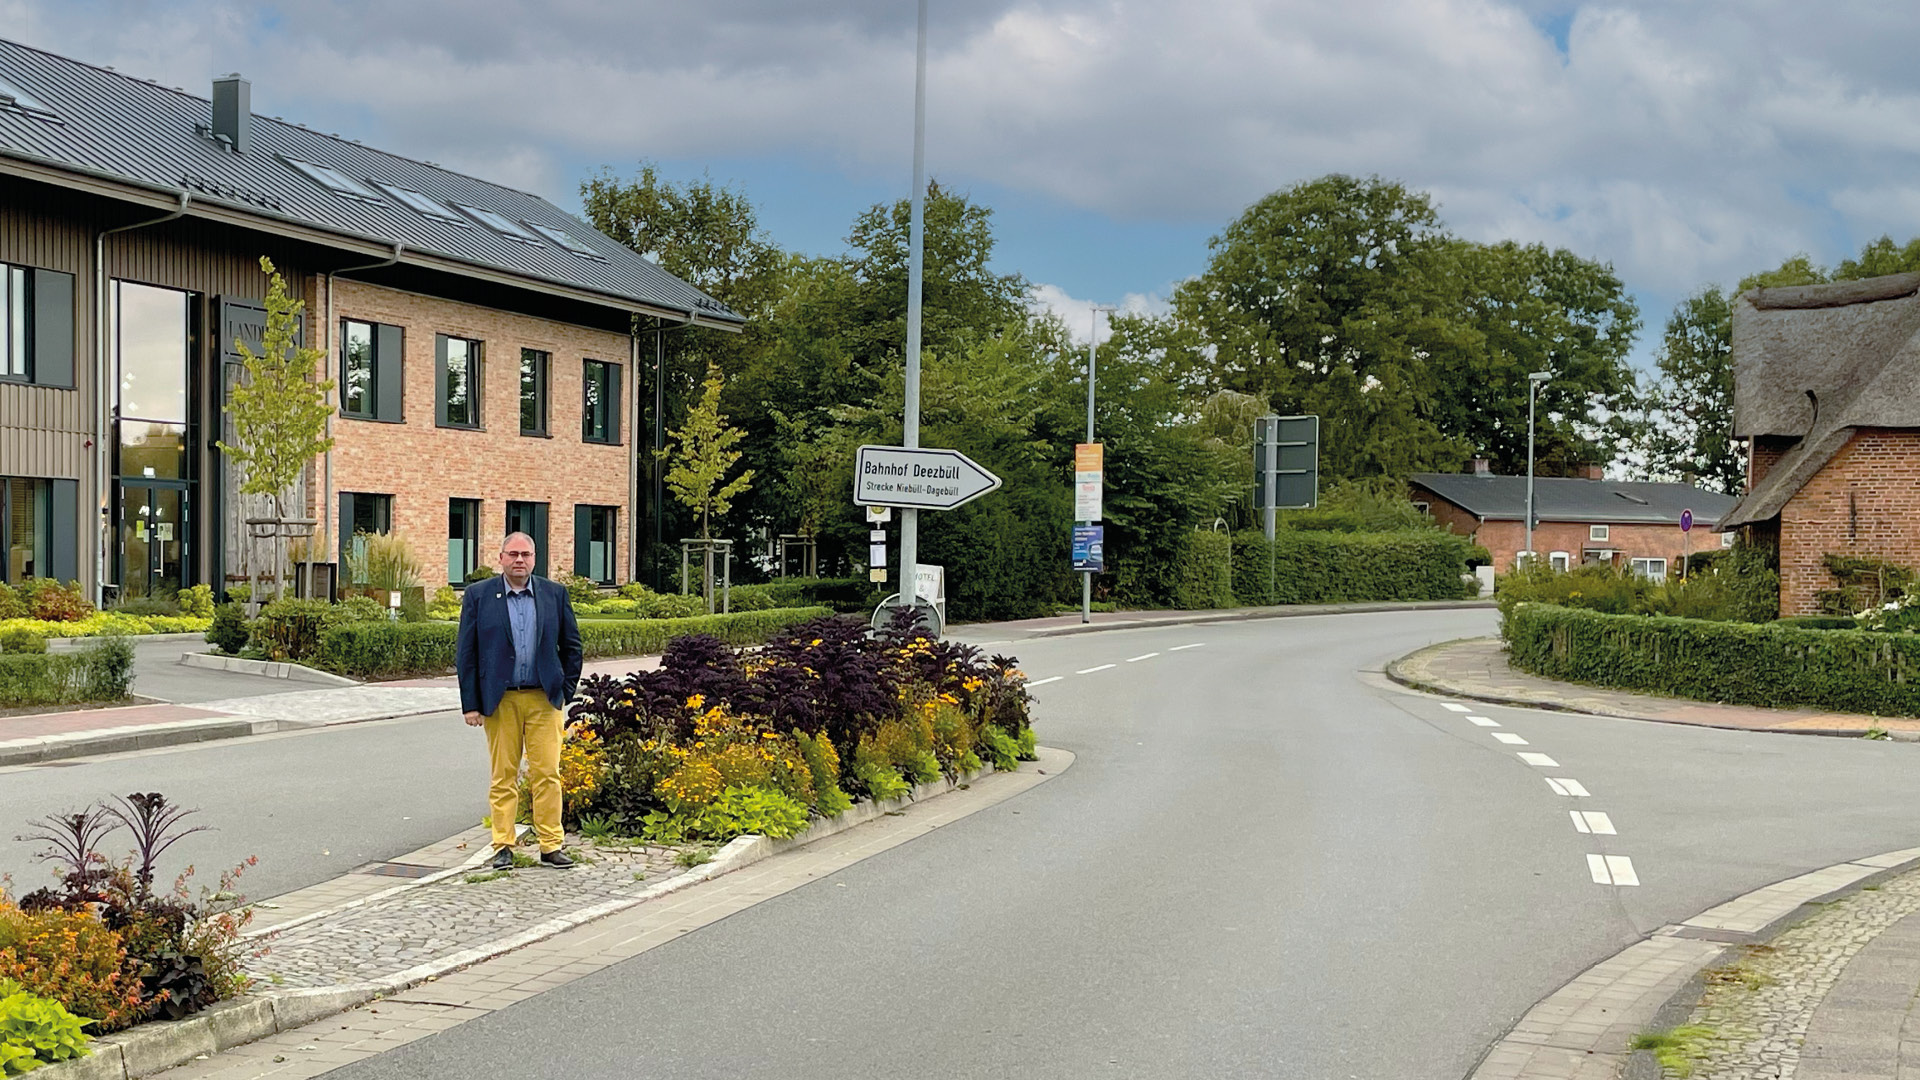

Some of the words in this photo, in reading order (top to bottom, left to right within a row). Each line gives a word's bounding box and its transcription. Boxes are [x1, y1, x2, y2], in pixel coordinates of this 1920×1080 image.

[865, 461, 909, 477] Bahnhof
[913, 464, 960, 480] Deezbüll
[866, 481, 894, 492] Strecke
[896, 483, 959, 497] Niebüll-Dagebüll
